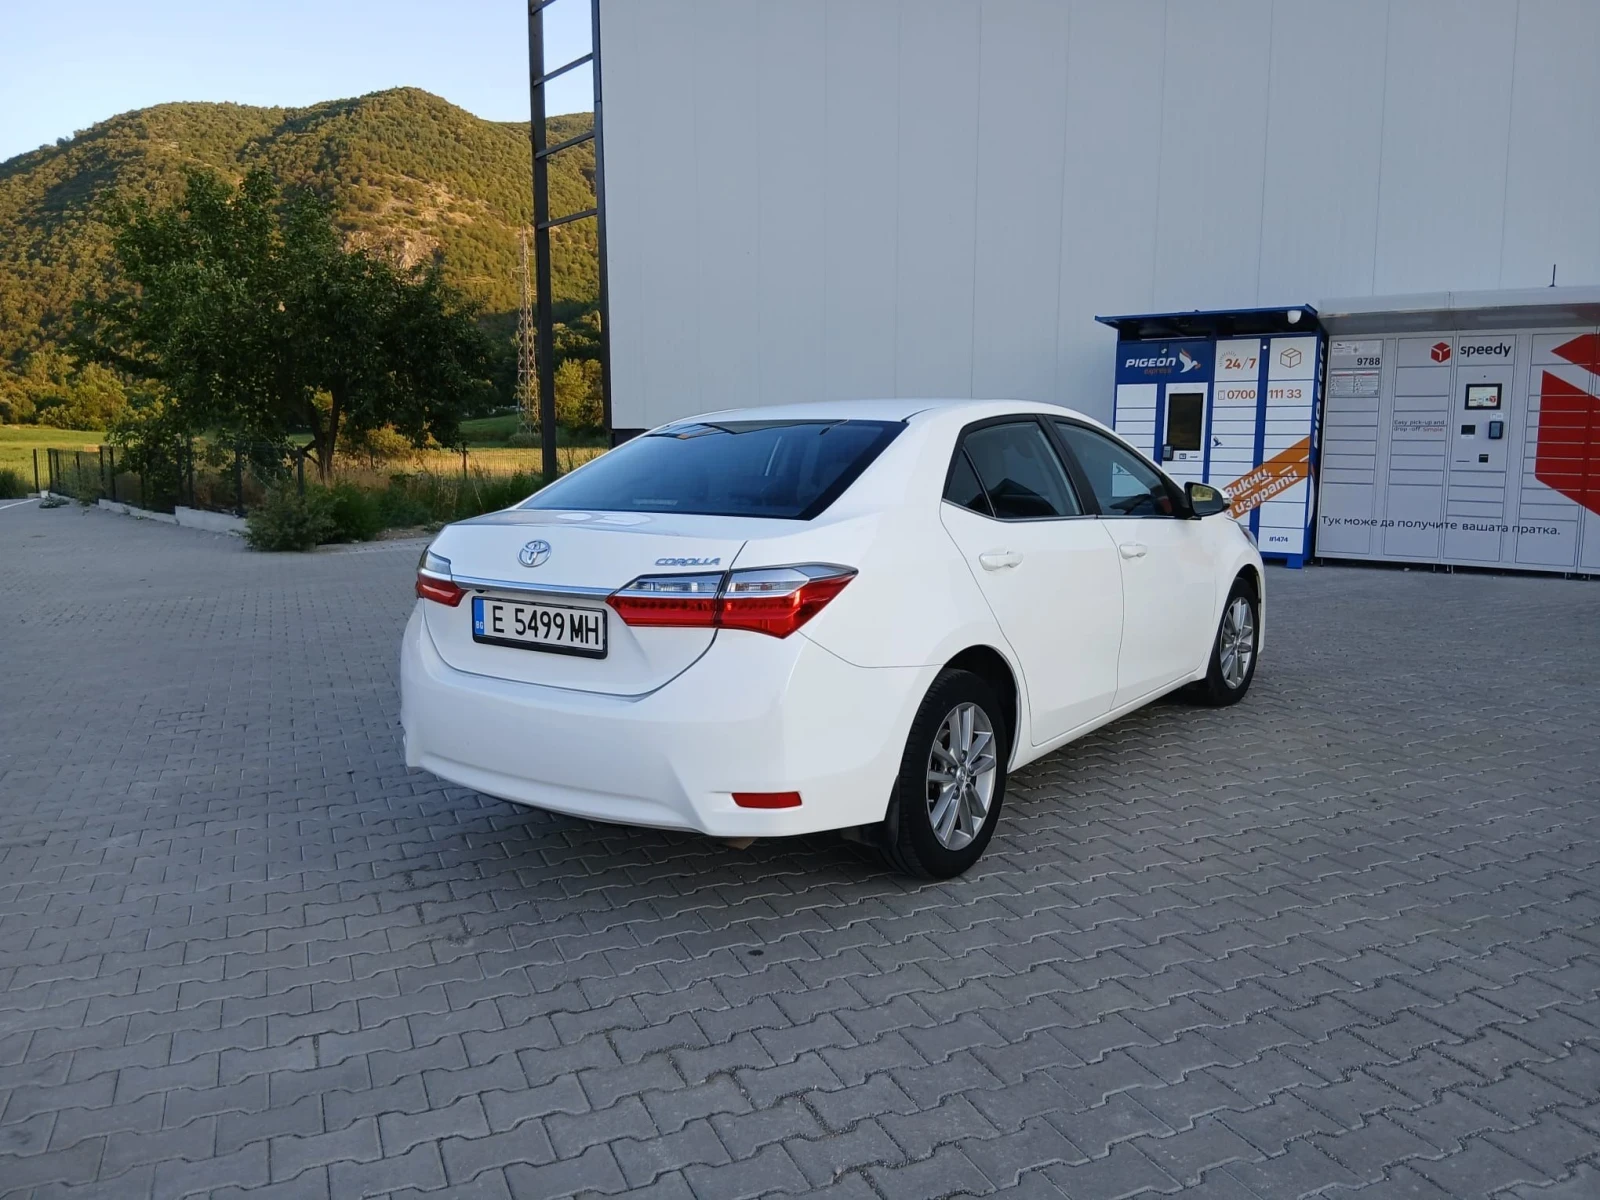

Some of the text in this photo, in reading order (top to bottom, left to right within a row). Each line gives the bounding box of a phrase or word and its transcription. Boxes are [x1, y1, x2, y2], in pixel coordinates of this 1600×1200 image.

[1460, 342, 1512, 358] speedy
[1125, 357, 1176, 368] PIGEON
[1224, 356, 1257, 370] 24/7
[1356, 357, 1380, 366] 9788
[1227, 388, 1302, 400] 0700 111 33
[1321, 515, 1561, 535] Тук може да получите вашата пратка.
[654, 557, 721, 567] COROLLA
[475, 620, 484, 630] BG
[492, 605, 599, 645] E 5499 MH
